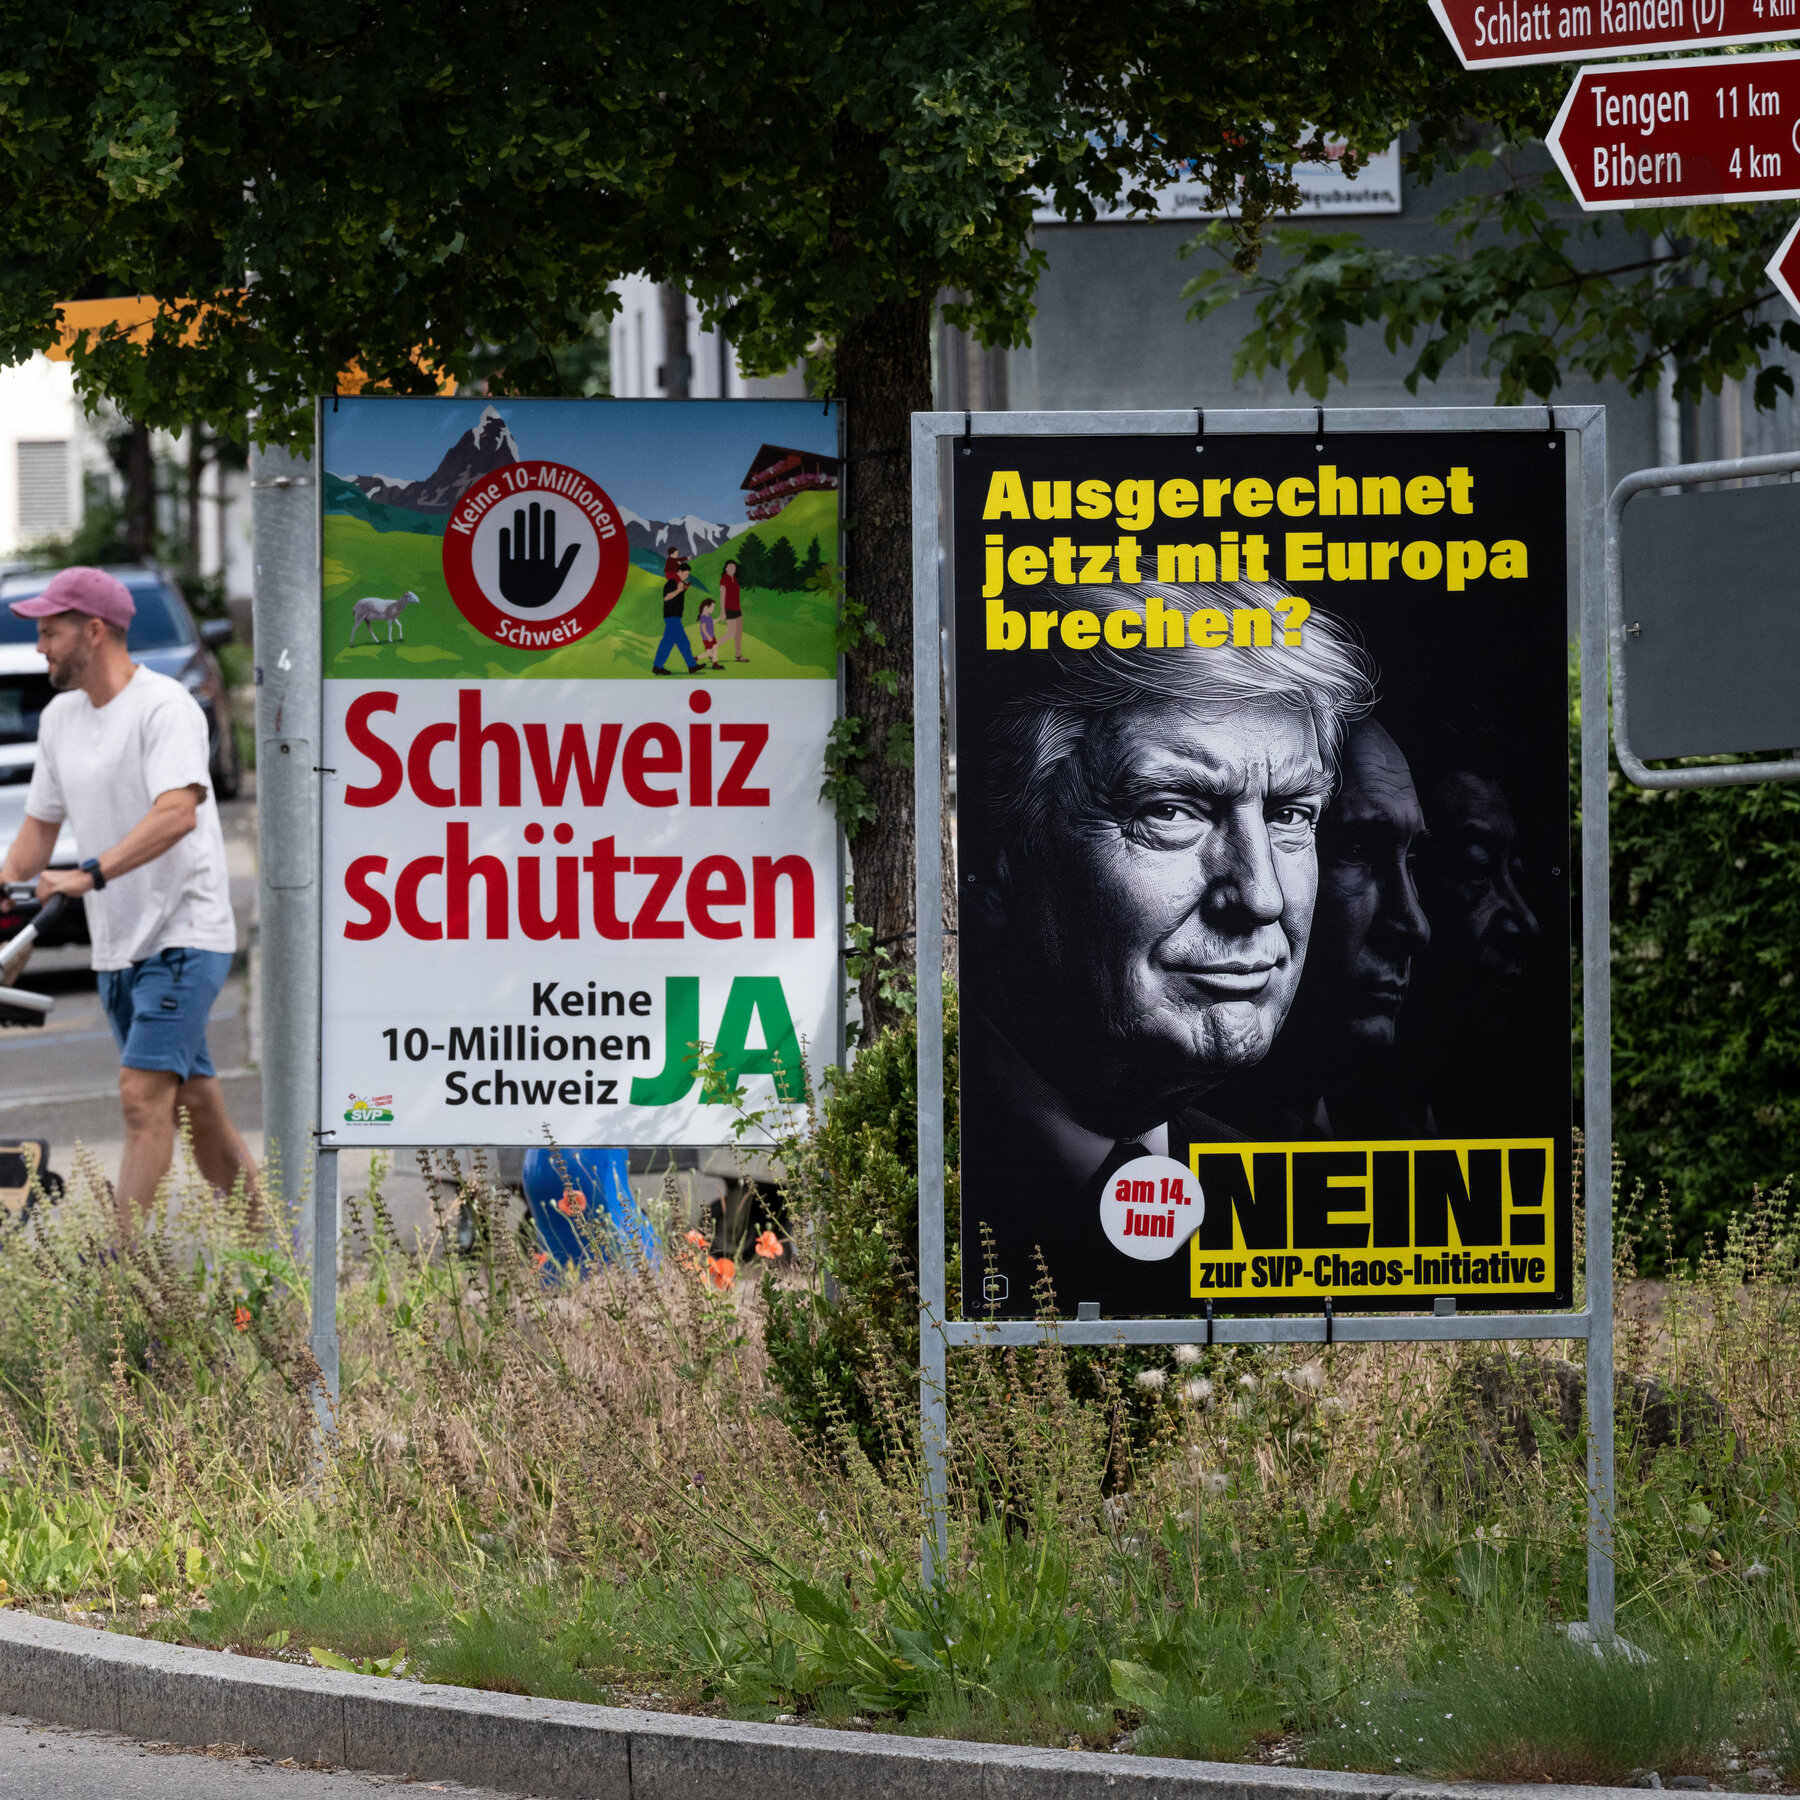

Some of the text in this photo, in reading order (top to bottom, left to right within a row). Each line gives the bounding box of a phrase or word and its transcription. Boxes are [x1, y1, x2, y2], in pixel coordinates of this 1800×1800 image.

[1474, 0, 1552, 47] Schlatt
[1558, 5, 1592, 39] am
[1600, 0, 1684, 34] Randen
[1692, 0, 1725, 33] (D)
[1591, 84, 1780, 136] Tengen 11 km
[1593, 142, 1781, 187] Bibern 4 km
[451, 466, 617, 539] Keine 10-Millionen
[982, 465, 1474, 531] Ausgerechnet
[982, 531, 1529, 598] jetzt mit Europa
[495, 618, 582, 646] Schweiz
[985, 597, 1311, 650] brechen?
[344, 689, 770, 808] Schweiz
[343, 821, 815, 941] schützen
[532, 981, 652, 1017] Keine
[382, 1025, 651, 1062] 10-Millionen
[629, 976, 807, 1107] JA
[445, 1069, 619, 1106] Schweiz
[351, 1109, 383, 1121] SVP
[1115, 1177, 1191, 1206] am 14.
[1198, 1147, 1547, 1250] NEIN!
[1123, 1208, 1175, 1238] Juni
[1199, 1253, 1546, 1289] zur SVP-Chaos-Initiative
